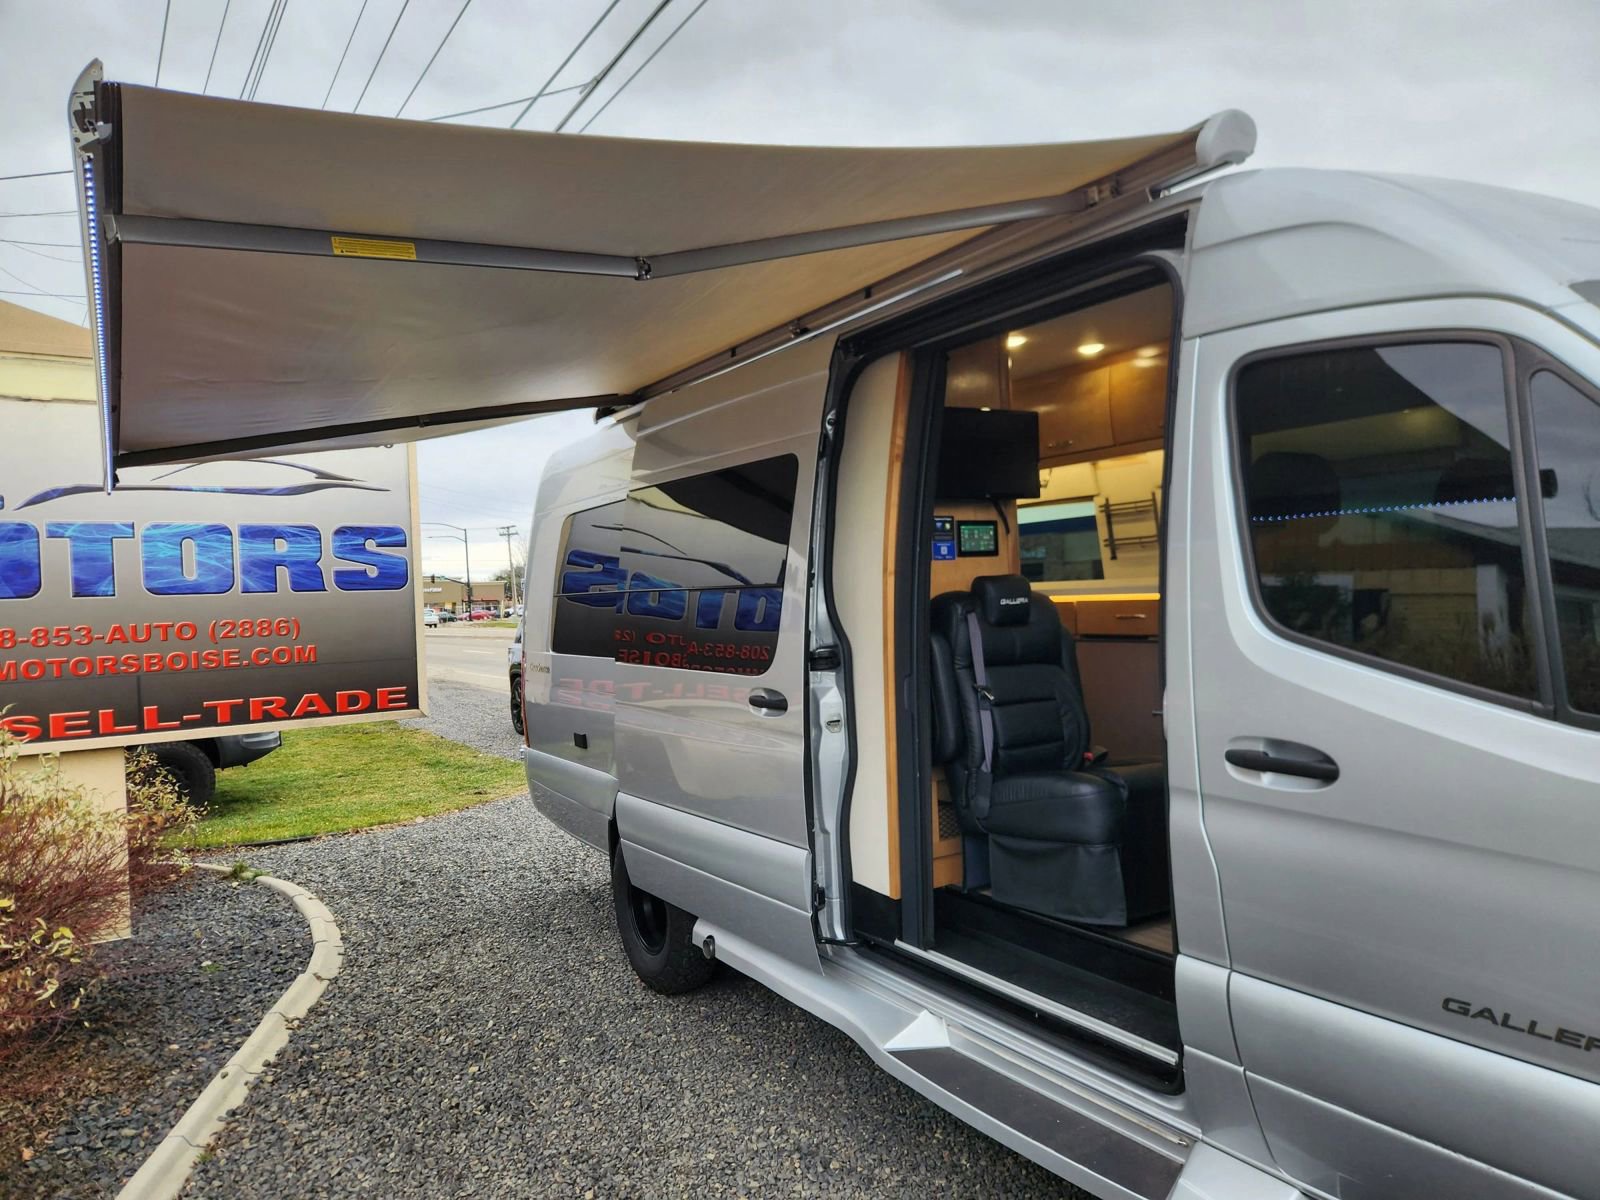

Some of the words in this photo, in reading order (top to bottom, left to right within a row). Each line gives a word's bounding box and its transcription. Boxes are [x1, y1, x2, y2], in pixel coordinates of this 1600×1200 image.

[0, 621, 197, 649] 8-853-AUTO
[209, 616, 300, 644] (2886)
[0, 645, 317, 681] MOTORSBOISE.COM
[0, 686, 408, 743] SELL-TRADE
